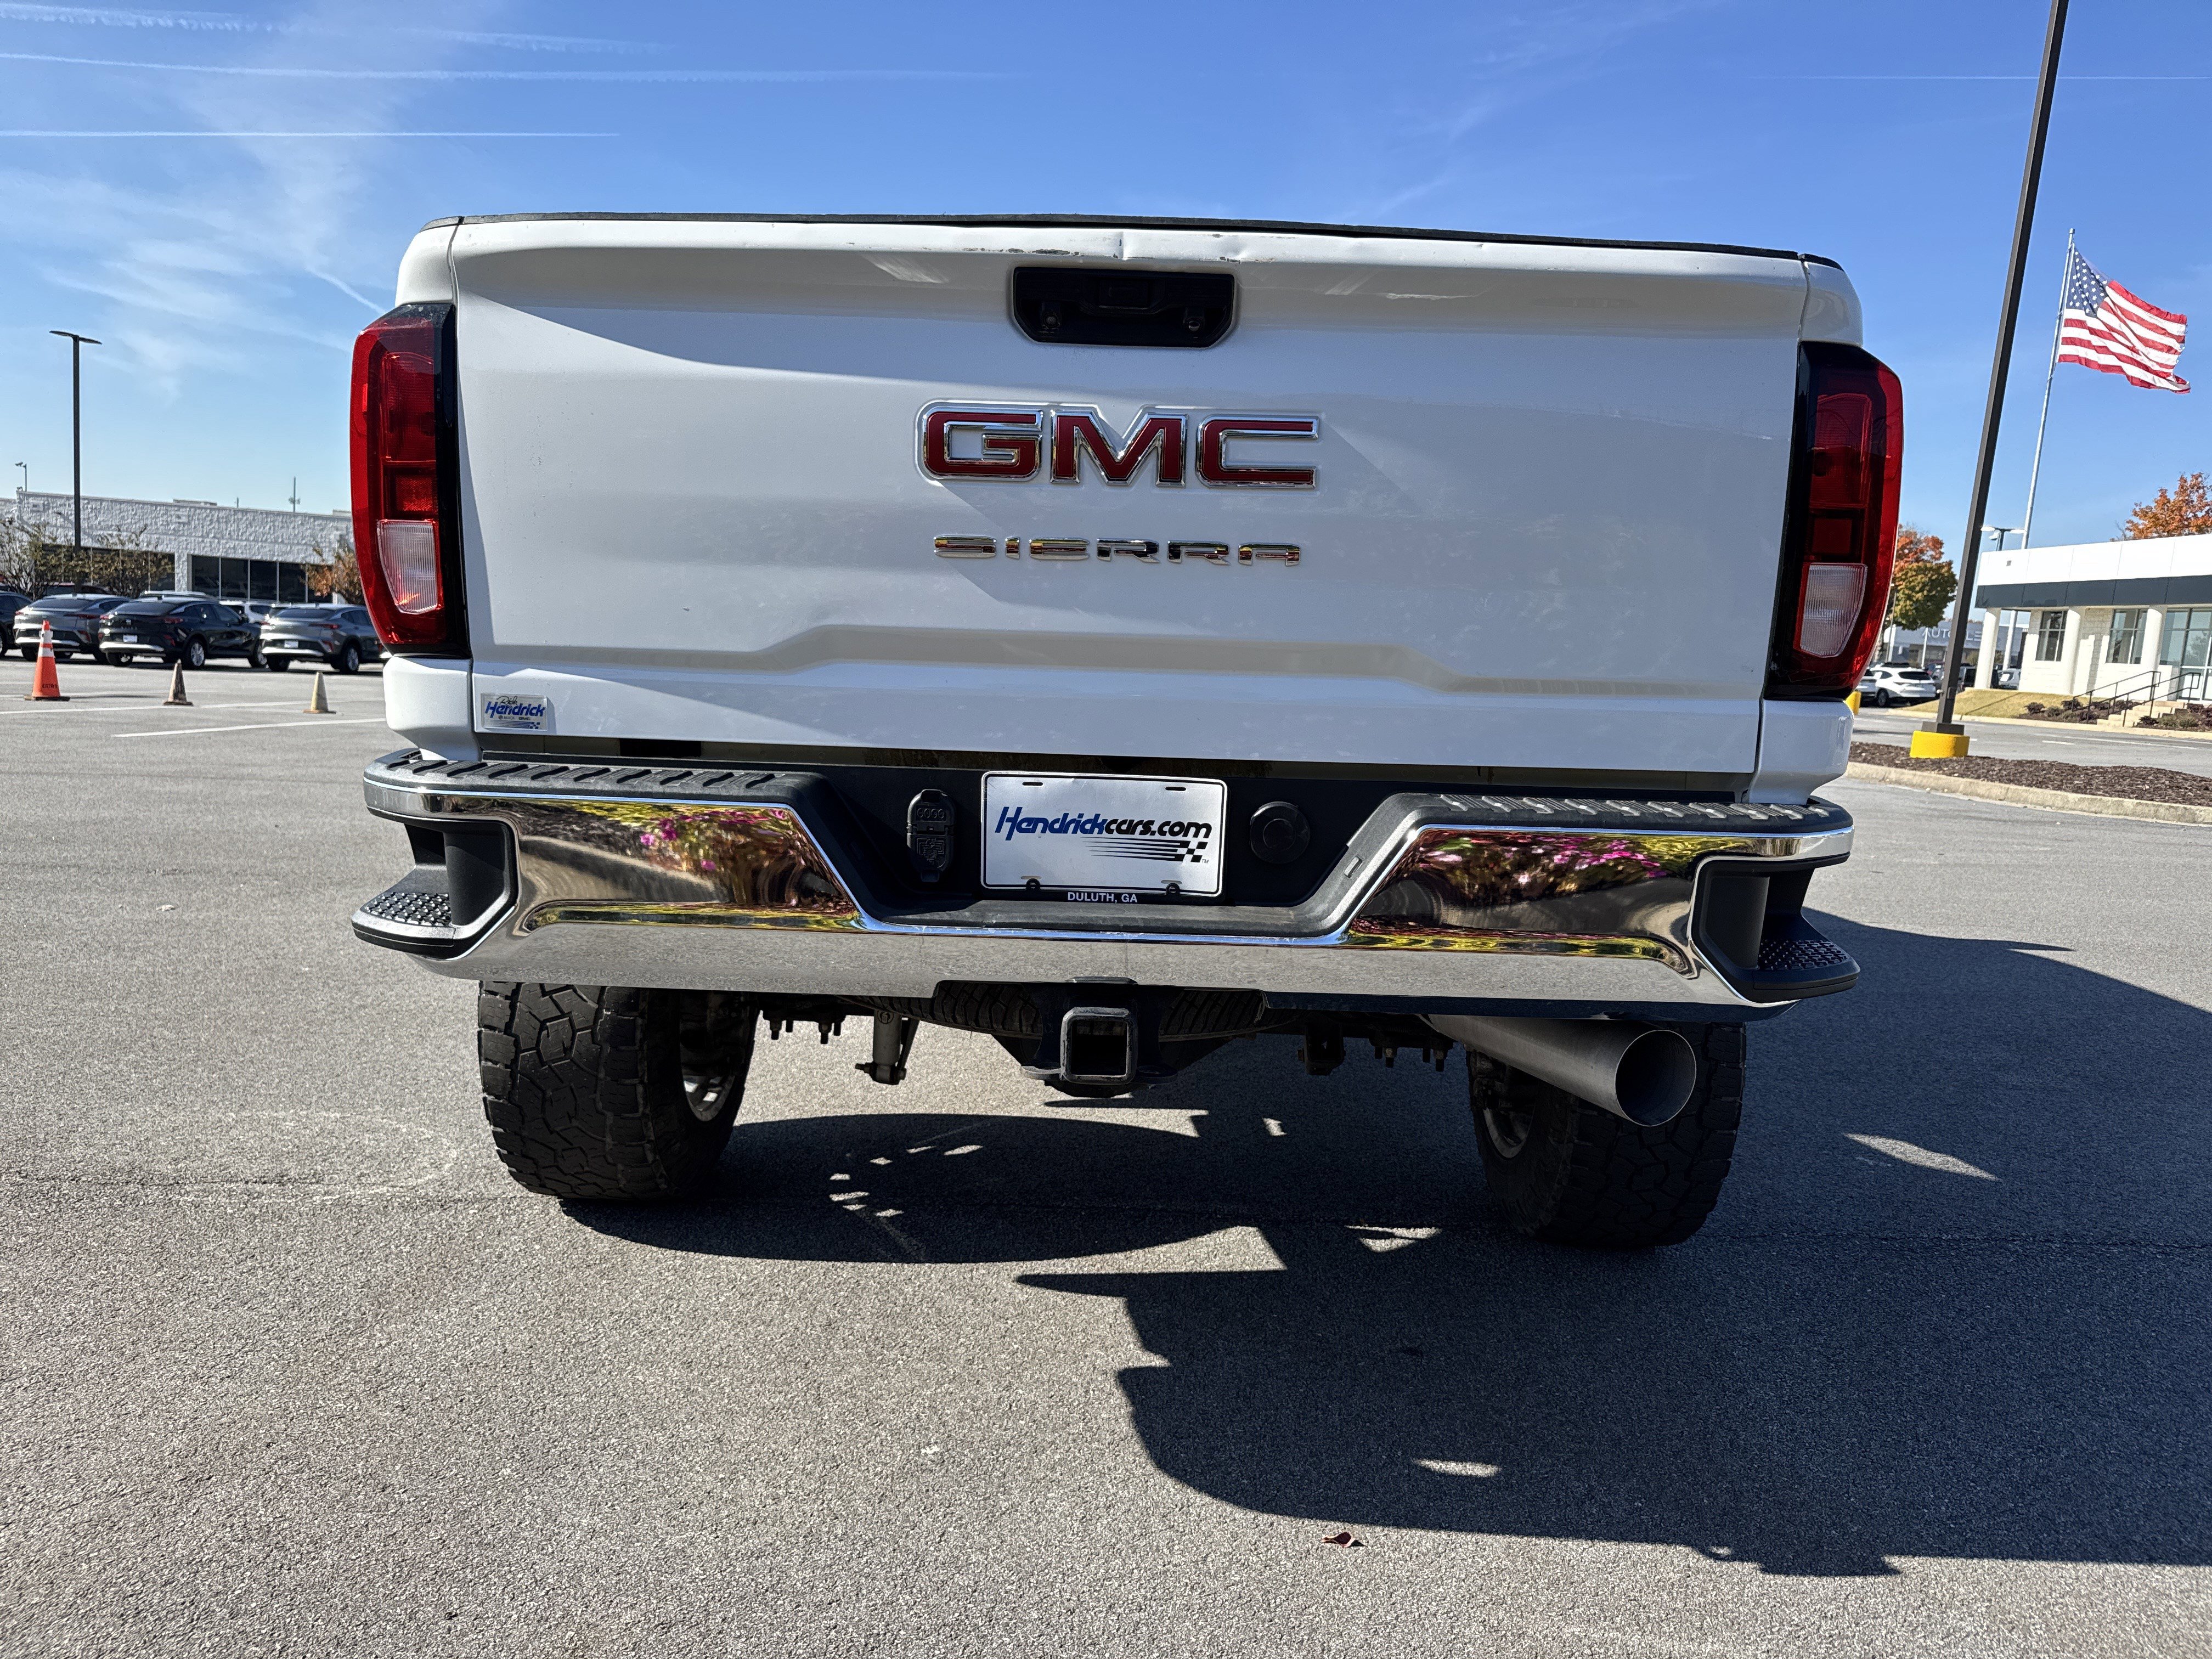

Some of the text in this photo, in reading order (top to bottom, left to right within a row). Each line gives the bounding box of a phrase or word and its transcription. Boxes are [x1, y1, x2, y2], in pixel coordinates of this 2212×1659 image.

[921, 405, 1319, 489] GMC
[933, 534, 1301, 566] SIERRA
[485, 701, 546, 718] Hendrick
[995, 806, 1211, 841] Hendrickcars.com
[1068, 891, 1138, 904] DULUTH, GA
